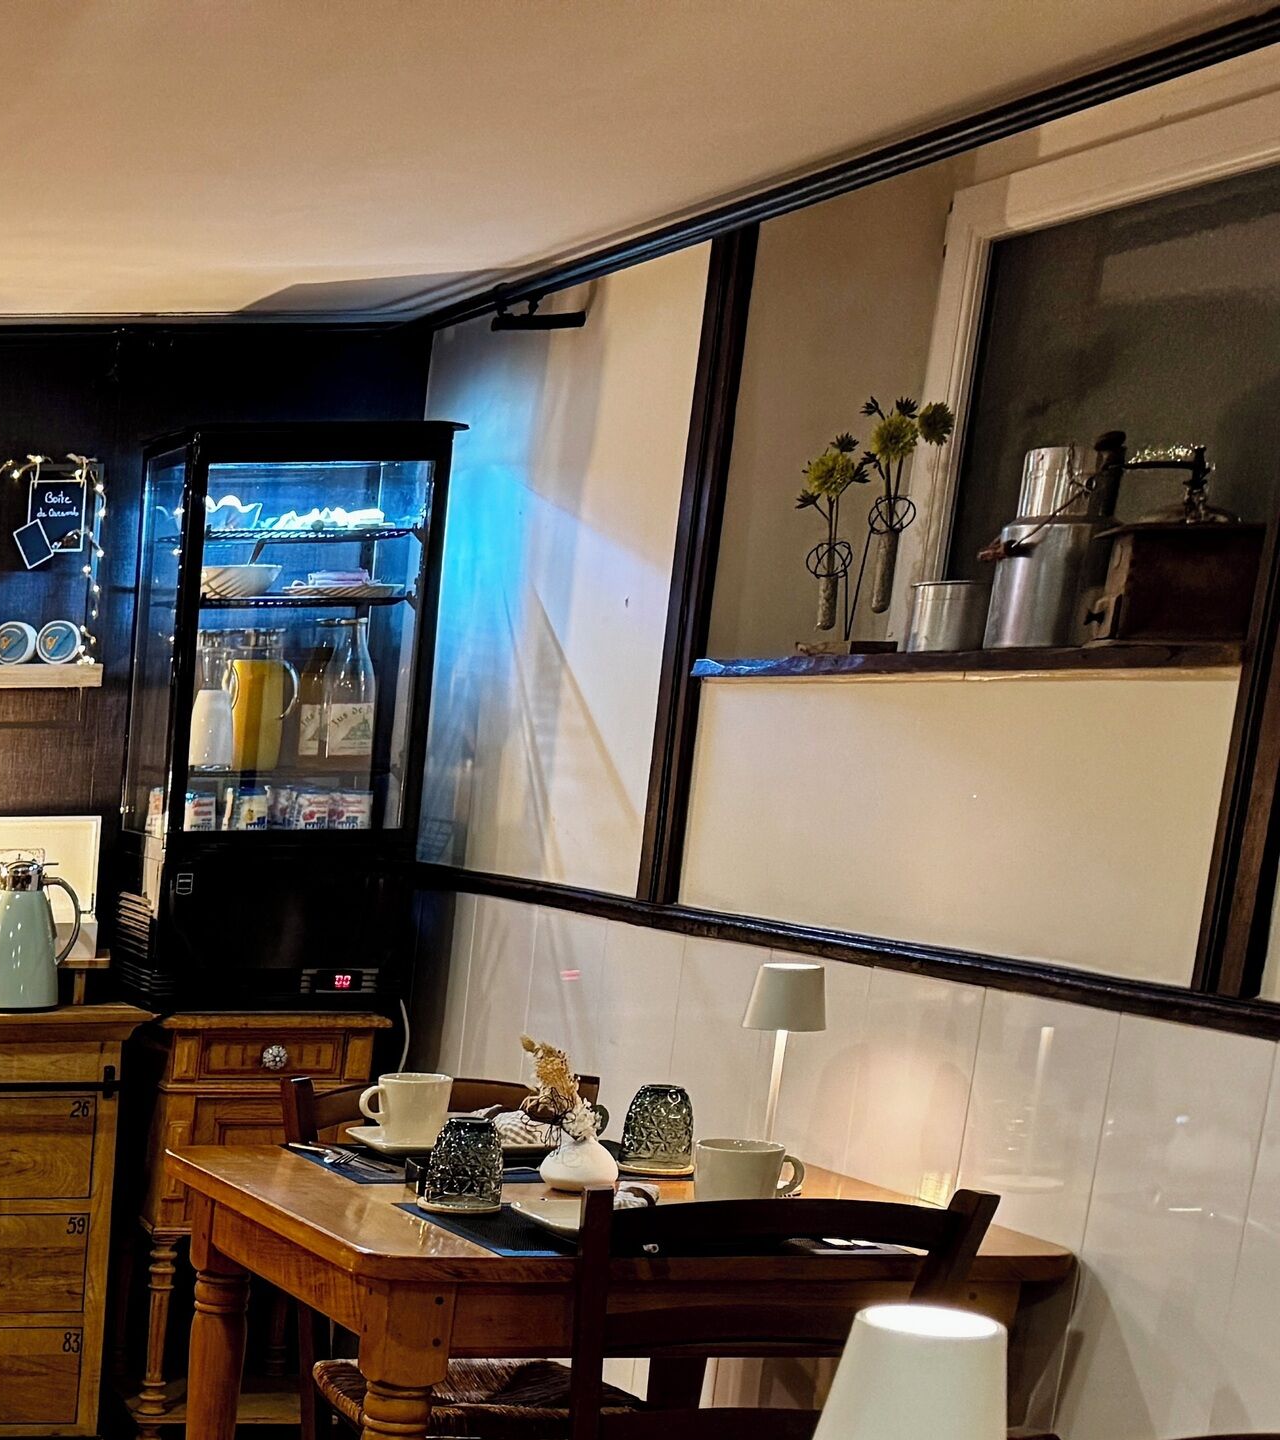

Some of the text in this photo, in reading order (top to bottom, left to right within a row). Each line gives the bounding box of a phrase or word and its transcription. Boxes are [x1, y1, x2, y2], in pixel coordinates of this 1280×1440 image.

[69, 1100, 90, 1118] 26
[66, 1216, 86, 1235] 59
[62, 1332, 81, 1353] 83
